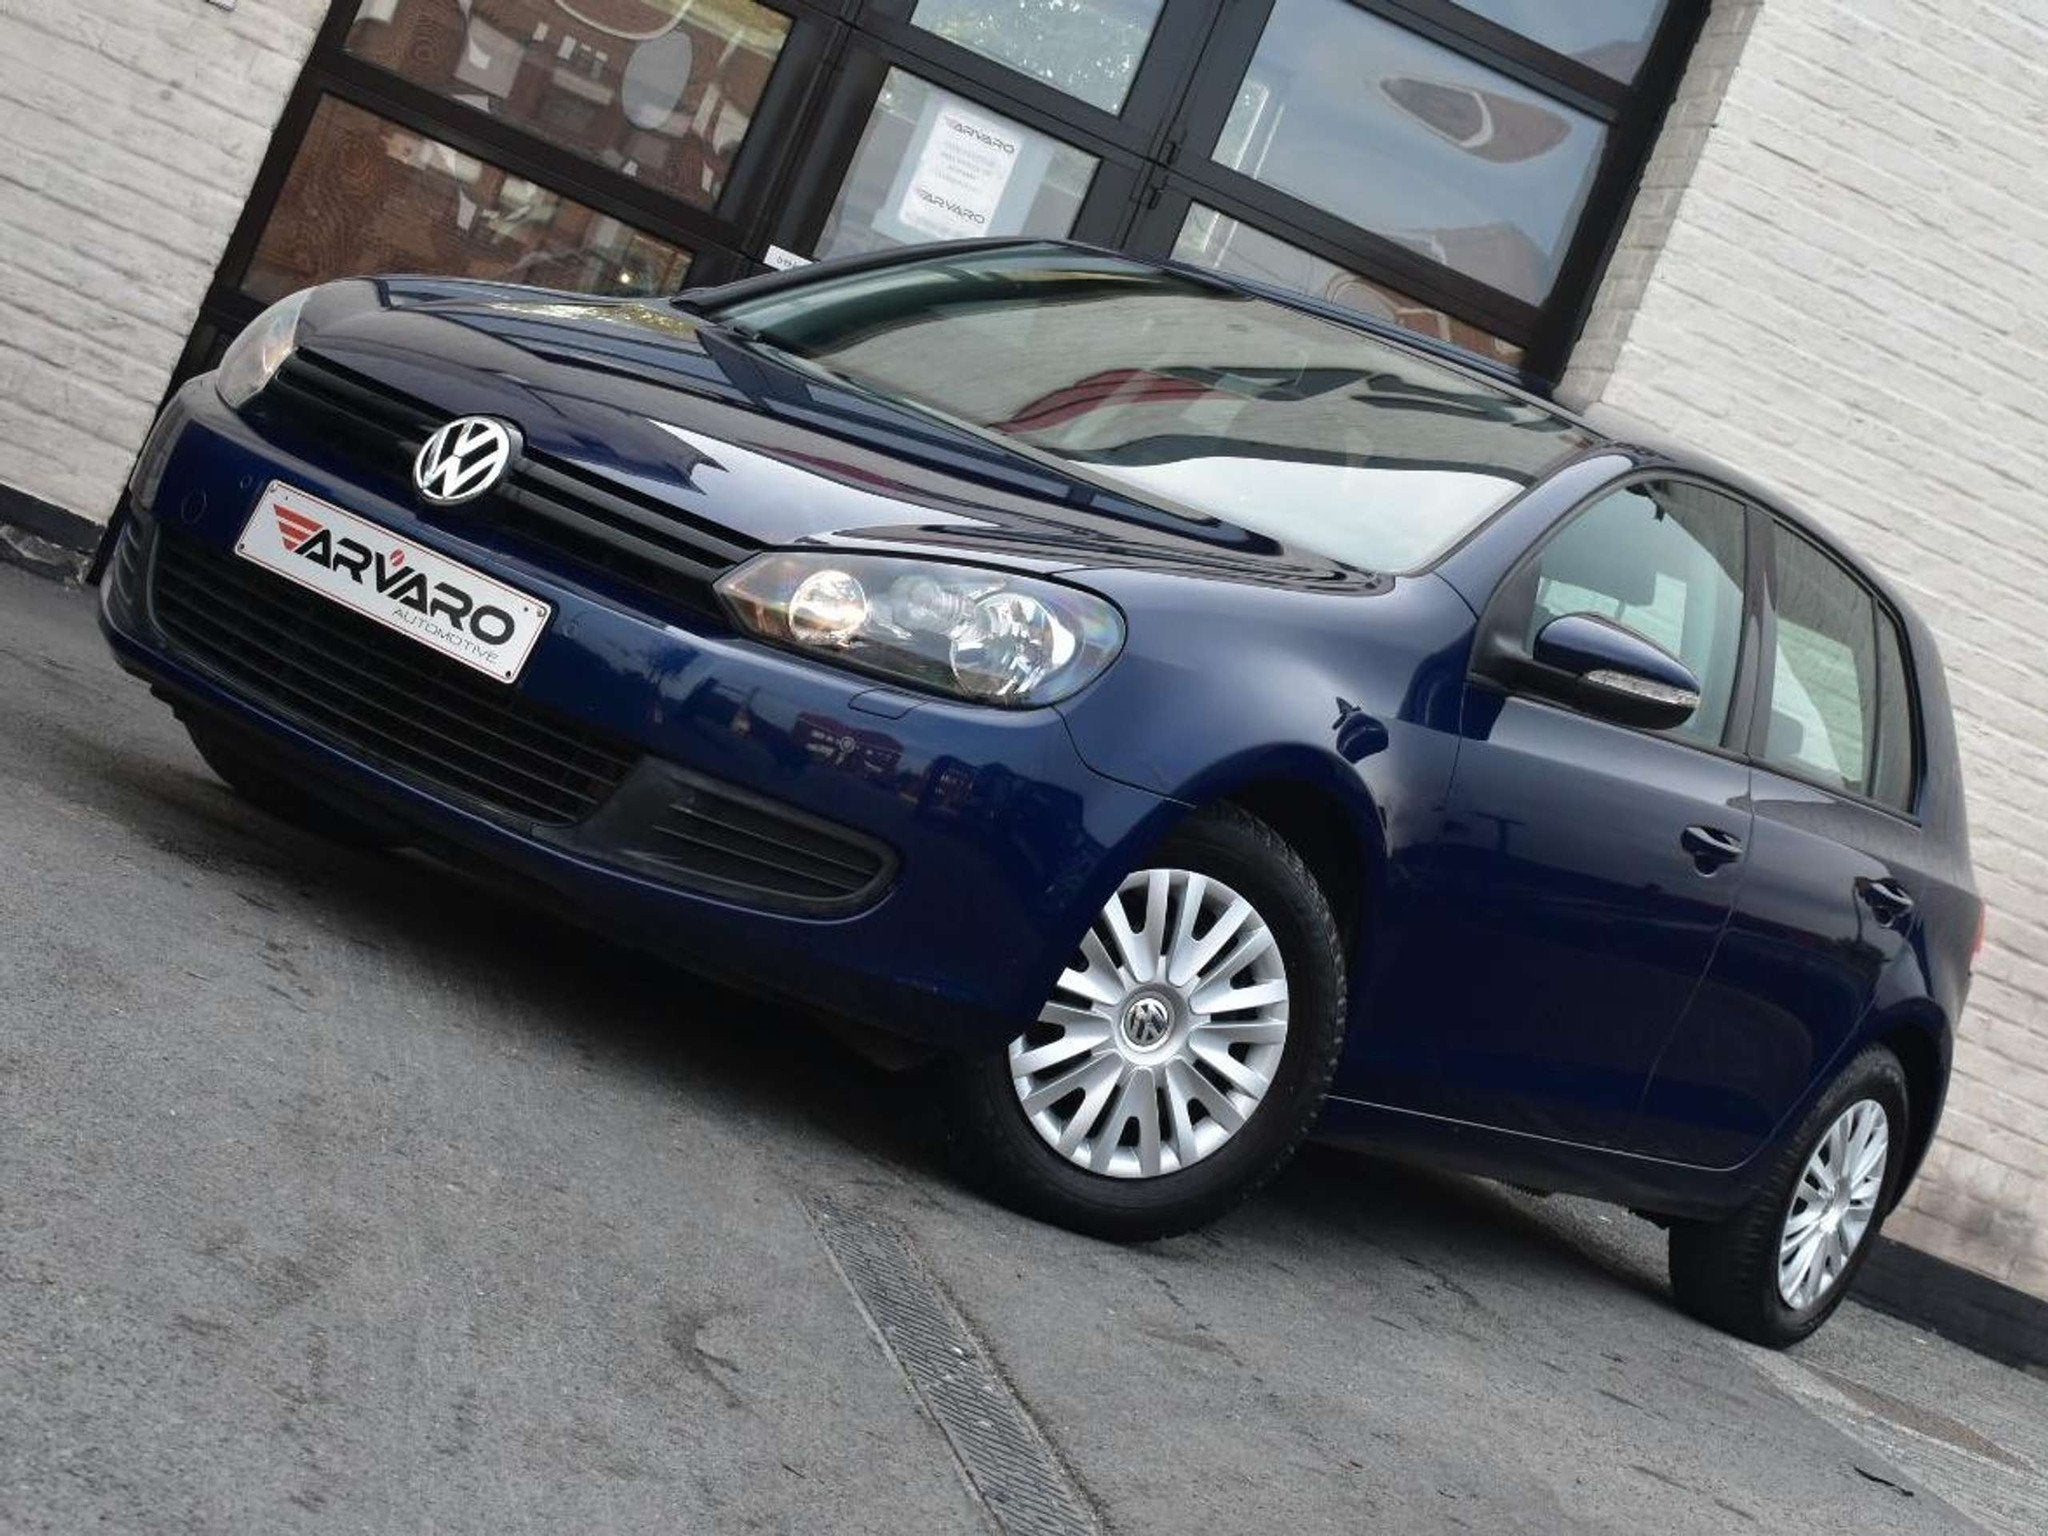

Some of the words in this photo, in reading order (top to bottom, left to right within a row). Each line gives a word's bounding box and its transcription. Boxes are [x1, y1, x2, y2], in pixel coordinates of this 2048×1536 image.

[952, 123, 1015, 154] ARVARO
[921, 191, 985, 224] ARVARO
[415, 416, 510, 500] VW
[294, 529, 515, 646] ARVARO
[393, 606, 500, 663] AUTOMOTIVE
